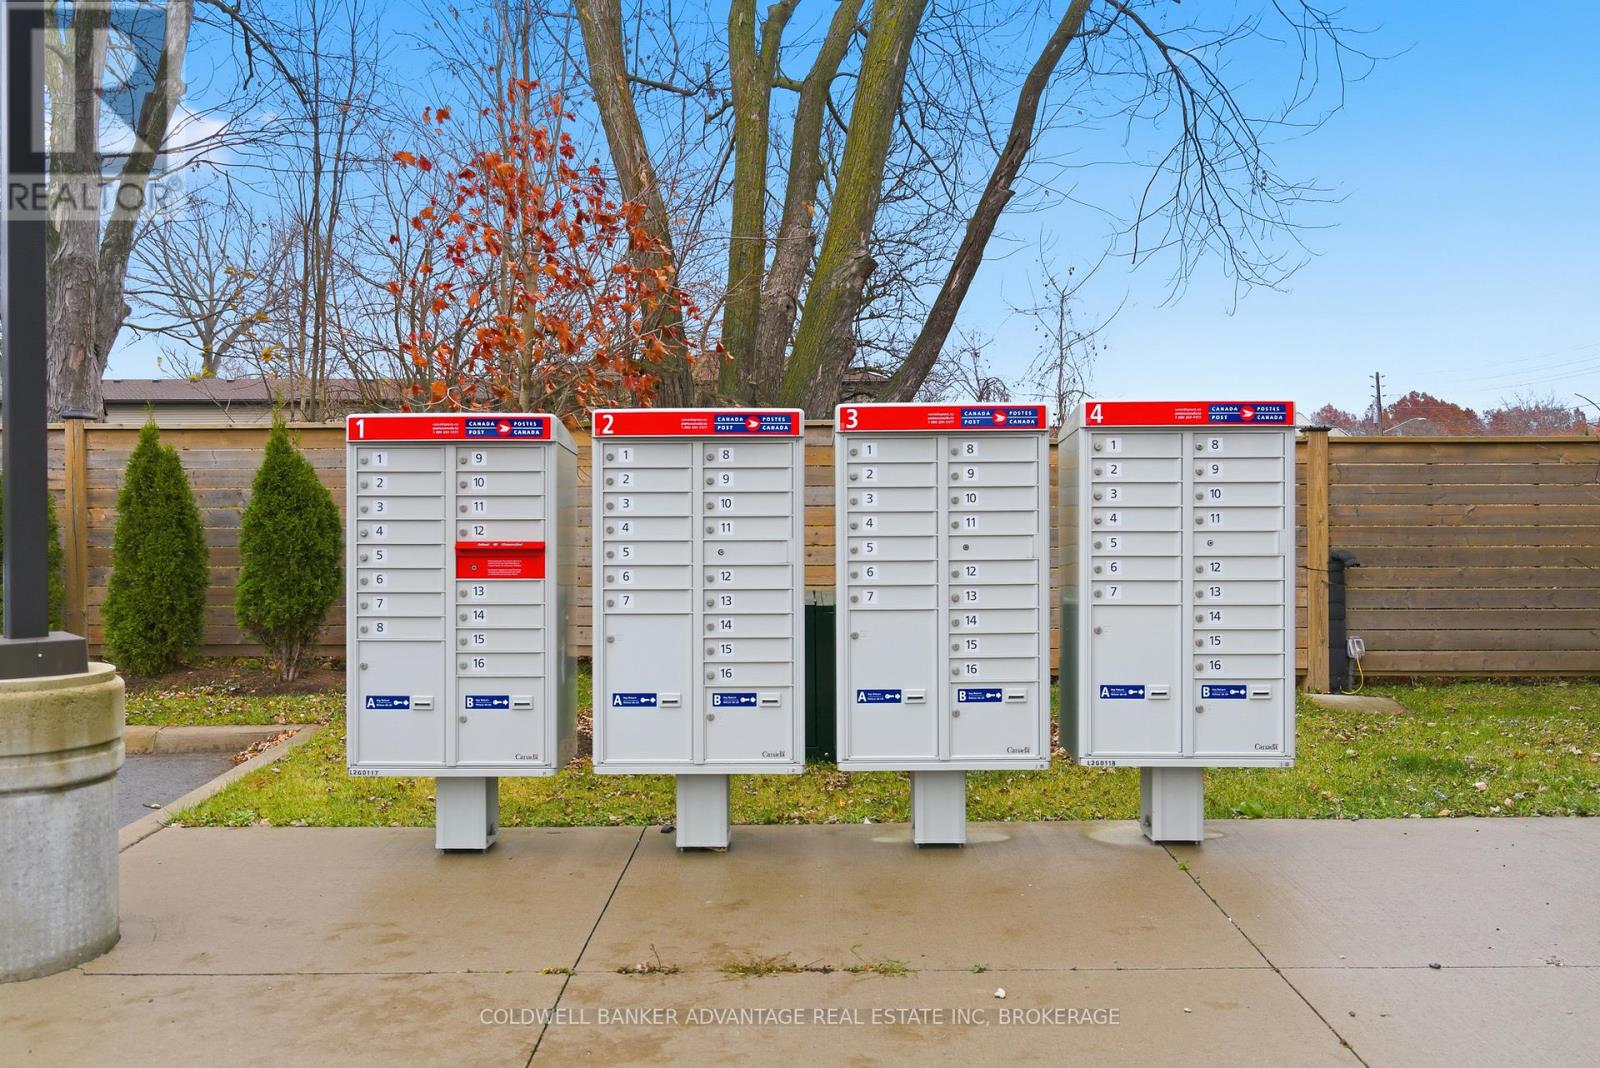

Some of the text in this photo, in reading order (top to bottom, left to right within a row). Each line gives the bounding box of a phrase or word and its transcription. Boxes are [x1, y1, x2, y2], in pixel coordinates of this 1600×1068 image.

[847, 409, 857, 428] 3
[1090, 404, 1103, 423] 4
[357, 419, 363, 438] 1
[603, 415, 613, 434] 2
[966, 443, 974, 455] 8
[1211, 439, 1219, 450] 8
[475, 453, 483, 463] 9
[722, 449, 730, 460] 8
[866, 468, 873, 480] 2
[967, 468, 975, 479] 9
[1110, 464, 1118, 475] 2
[1211, 464, 1219, 475] 9
[376, 477, 384, 488] 2
[473, 477, 485, 488] 10
[622, 473, 630, 485] 2
[722, 473, 730, 484] 9
[866, 493, 874, 504] 3
[965, 492, 977, 503] 10
[1110, 488, 1118, 499] 3
[1210, 488, 1222, 499] 10
[376, 501, 384, 512] 3
[473, 501, 484, 511] 11
[623, 498, 630, 509] 3
[720, 498, 732, 509] 10
[865, 517, 874, 528] 4
[965, 517, 976, 528] 11
[1109, 513, 1118, 523] 4
[1210, 513, 1220, 524] 11
[375, 525, 384, 536] 4
[474, 525, 484, 536] 12
[621, 522, 629, 532] 4
[720, 522, 731, 533] 11
[866, 542, 874, 553] 5
[1110, 537, 1118, 548] 5
[376, 550, 383, 560] 5
[622, 546, 630, 557] 5
[866, 566, 874, 577] 6
[965, 566, 977, 577] 12
[1110, 561, 1118, 573] 6
[1210, 561, 1221, 573] 12
[376, 574, 384, 585] 6
[622, 571, 630, 582] 6
[720, 571, 732, 582] 12
[472, 585, 485, 597] 13
[866, 591, 874, 601] 7
[966, 590, 977, 601] 13
[1110, 586, 1117, 597] 7
[1209, 586, 1221, 597] 13
[376, 598, 384, 609] 7
[623, 595, 630, 606] 7
[721, 595, 732, 606] 13
[473, 609, 485, 620] 14
[965, 615, 977, 625] 14
[1209, 611, 1221, 622] 14
[376, 622, 384, 633] 8
[720, 619, 732, 630] 14
[473, 633, 485, 644] 15
[1209, 635, 1221, 646] 15
[720, 643, 732, 654] 15
[965, 639, 978, 650] 15
[473, 658, 485, 669] 16
[966, 663, 978, 674] 16
[1209, 659, 1222, 671] 16
[720, 668, 733, 679] 16
[858, 691, 866, 702] A
[959, 691, 966, 701] B
[1101, 687, 1109, 697] A
[1203, 687, 1210, 697] B
[367, 697, 375, 708] A
[467, 697, 474, 707] B
[614, 695, 622, 705] A
[714, 695, 721, 705] B
